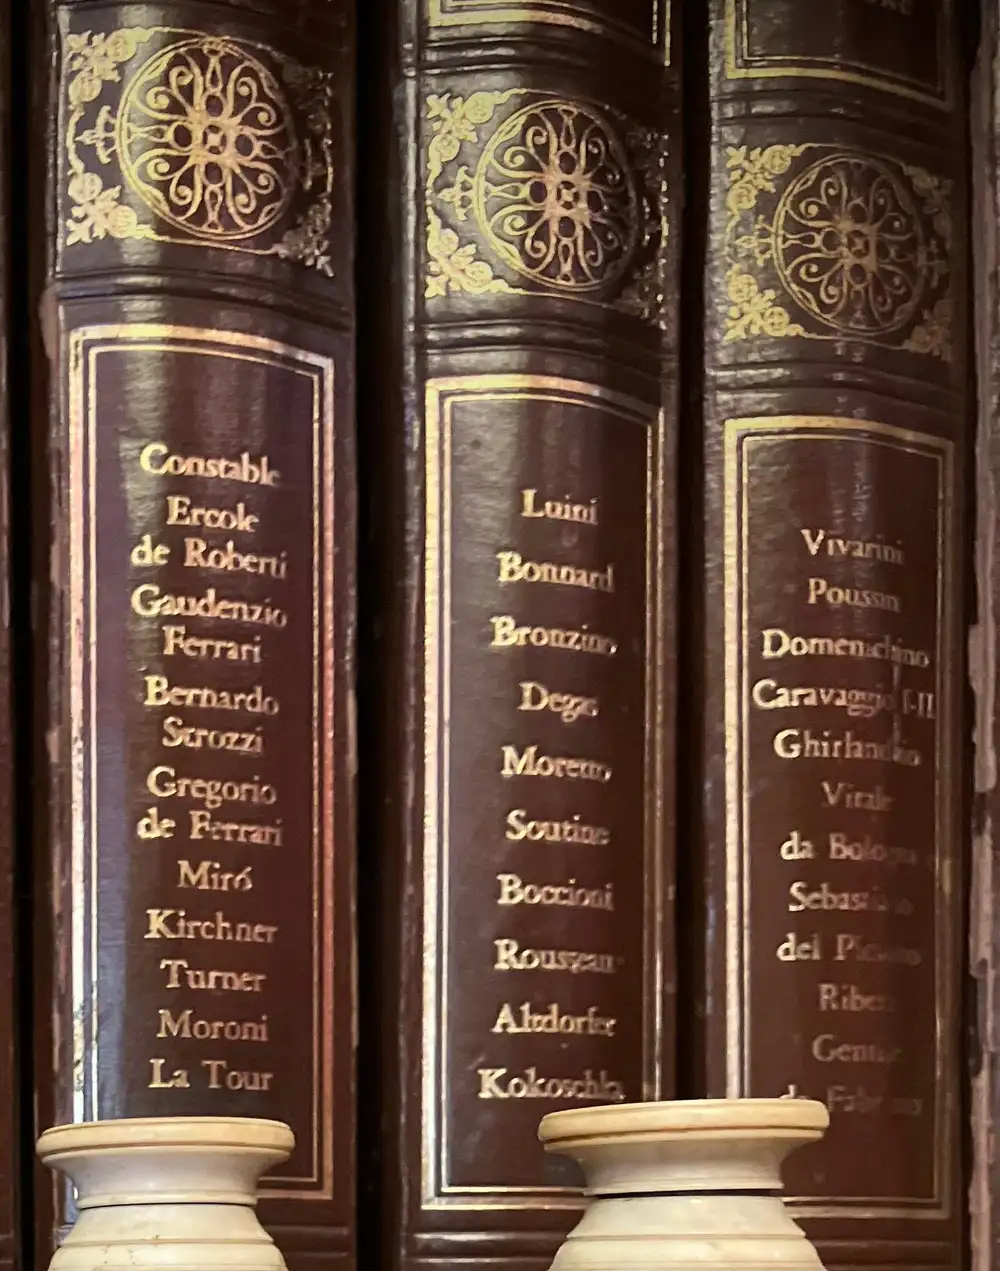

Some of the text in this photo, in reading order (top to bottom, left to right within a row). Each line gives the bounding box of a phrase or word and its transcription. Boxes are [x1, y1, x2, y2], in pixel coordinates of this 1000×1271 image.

[139, 443, 281, 487] Constable
[166, 495, 260, 533] Ercole
[521, 488, 598, 526] Luini
[130, 534, 288, 580] de Roberti
[801, 528, 903, 565] Vivarini
[496, 550, 615, 593] Bonnard
[131, 583, 288, 628] Gaudenzio
[807, 577, 900, 613] Poussin
[162, 625, 262, 663] Ferrari
[143, 675, 280, 716] Bernardo
[162, 716, 263, 753] Strozzi
[147, 765, 277, 809] Gregorio
[137, 807, 284, 847] de Ferrari
[780, 830, 814, 861] da
[177, 860, 253, 891] Miró
[496, 873, 614, 911] Boccioni
[143, 908, 279, 944] Kirchner
[776, 932, 821, 962] del
[159, 958, 267, 992] Turner
[156, 1009, 268, 1042] Moroni
[148, 1057, 275, 1091] La Tour
